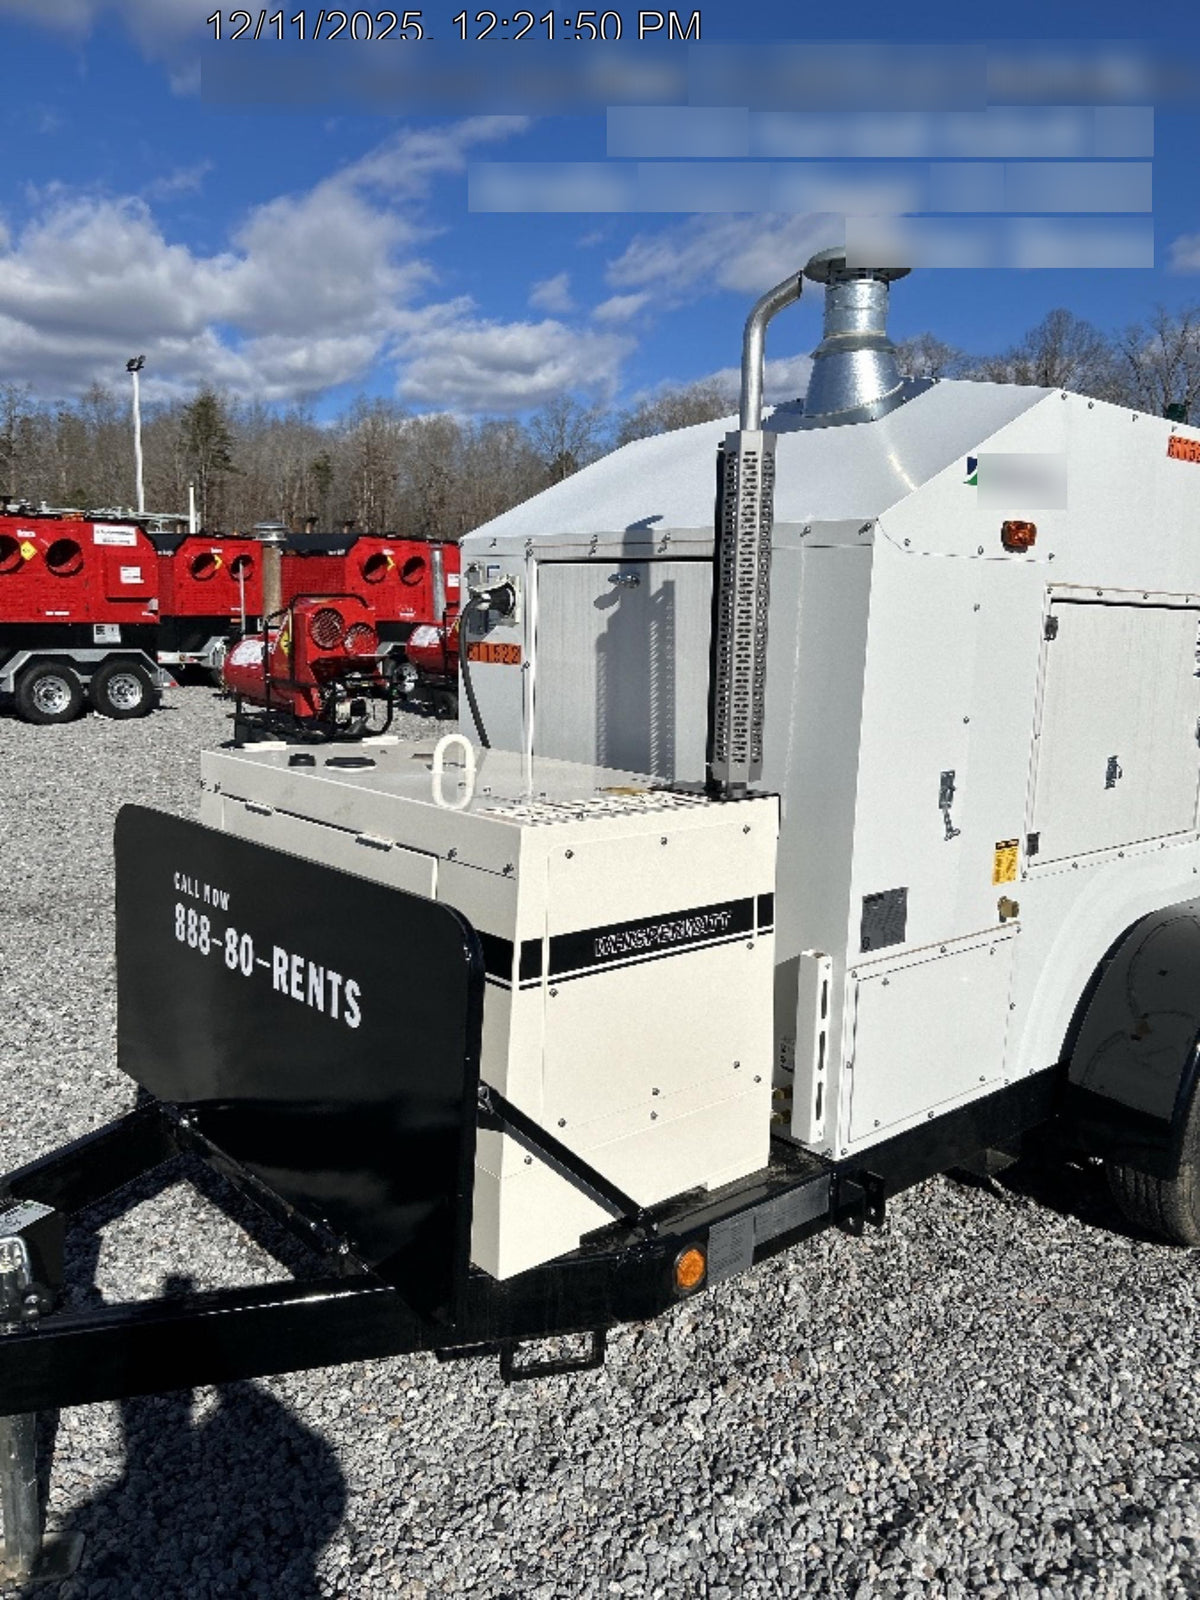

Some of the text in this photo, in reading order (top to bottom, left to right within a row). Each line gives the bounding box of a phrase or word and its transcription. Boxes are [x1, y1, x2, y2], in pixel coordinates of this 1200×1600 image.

[173, 871, 230, 911] CALL NOW
[175, 902, 362, 1029] 888-80-RENTS
